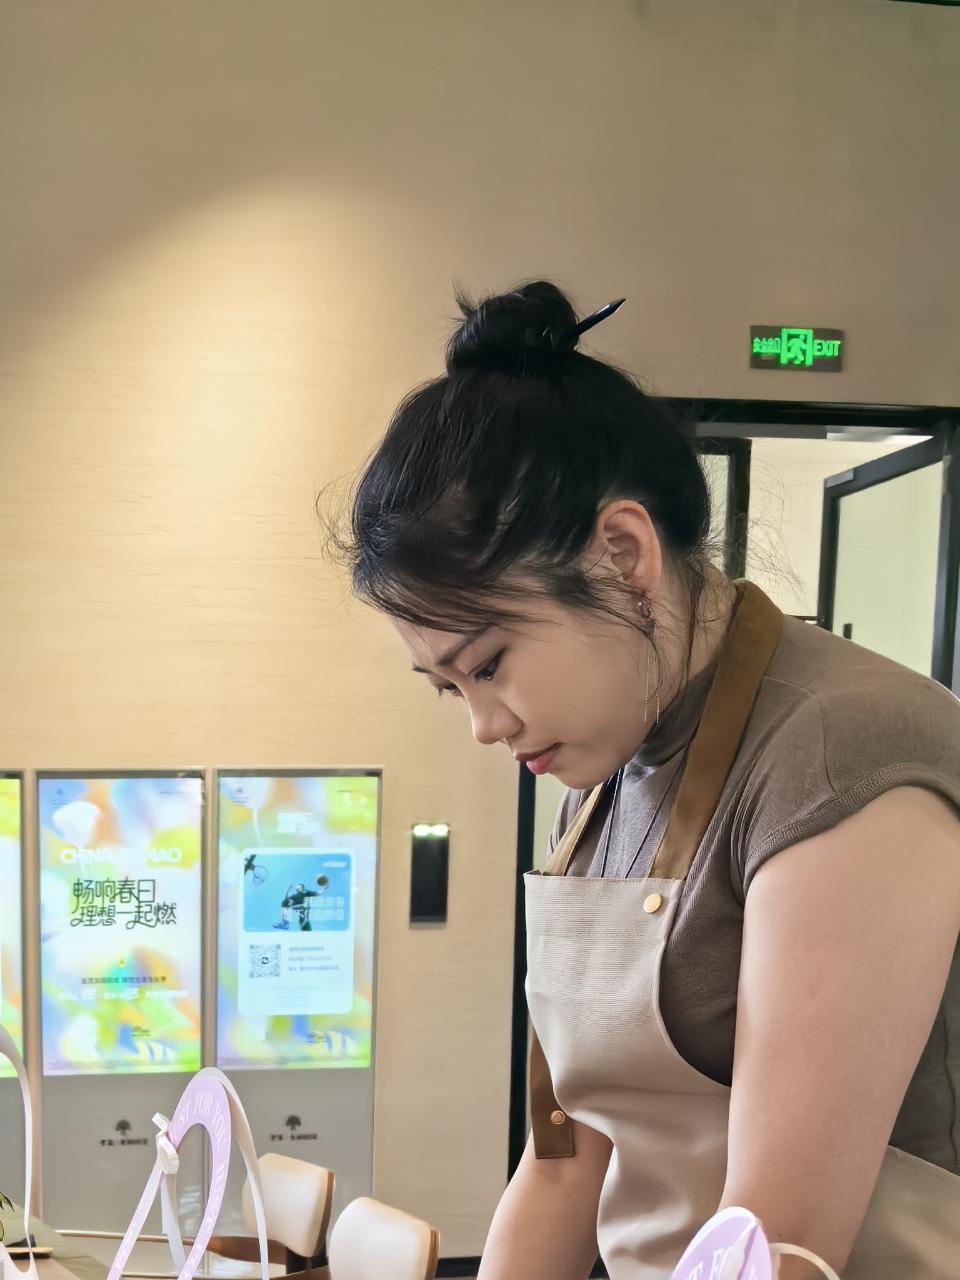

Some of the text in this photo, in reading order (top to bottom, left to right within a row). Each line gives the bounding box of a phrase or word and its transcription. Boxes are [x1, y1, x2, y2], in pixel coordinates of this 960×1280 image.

[814, 339, 840, 357] EXIT
[71, 876, 156, 910] 畅响春日
[70, 901, 178, 930] 理想一起燃
